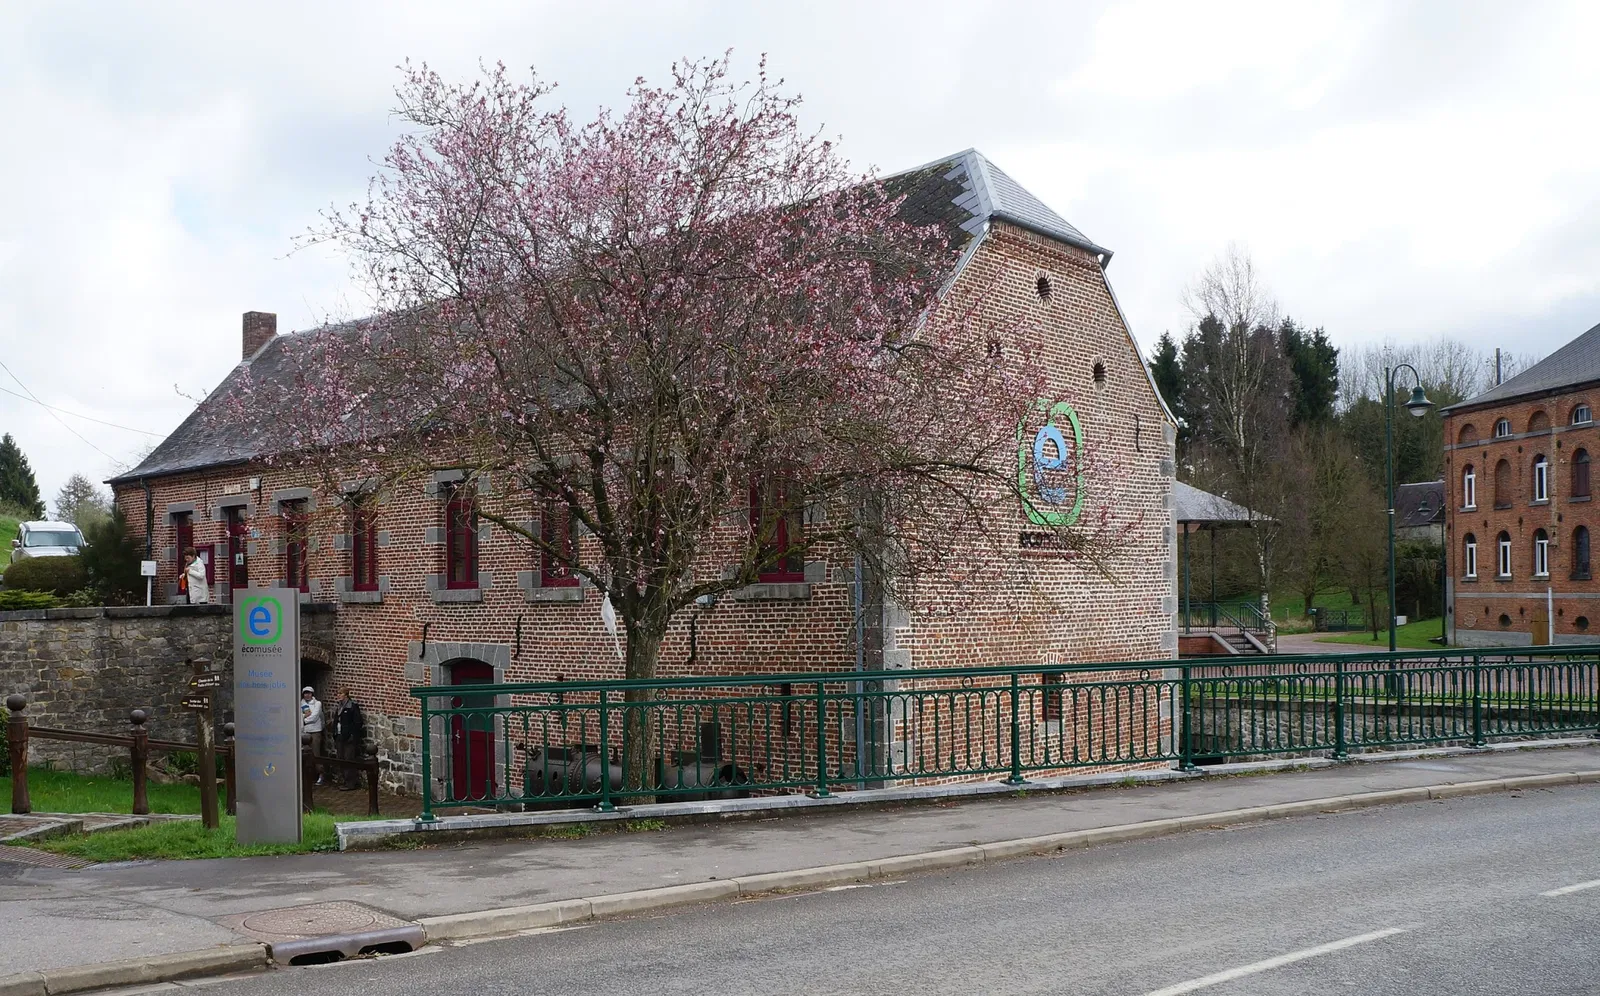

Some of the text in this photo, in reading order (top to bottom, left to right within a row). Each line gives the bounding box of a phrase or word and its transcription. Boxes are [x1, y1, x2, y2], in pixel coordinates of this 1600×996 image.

[249, 606, 272, 636] e
[241, 644, 283, 653] écomusée
[247, 669, 273, 678] Musée
